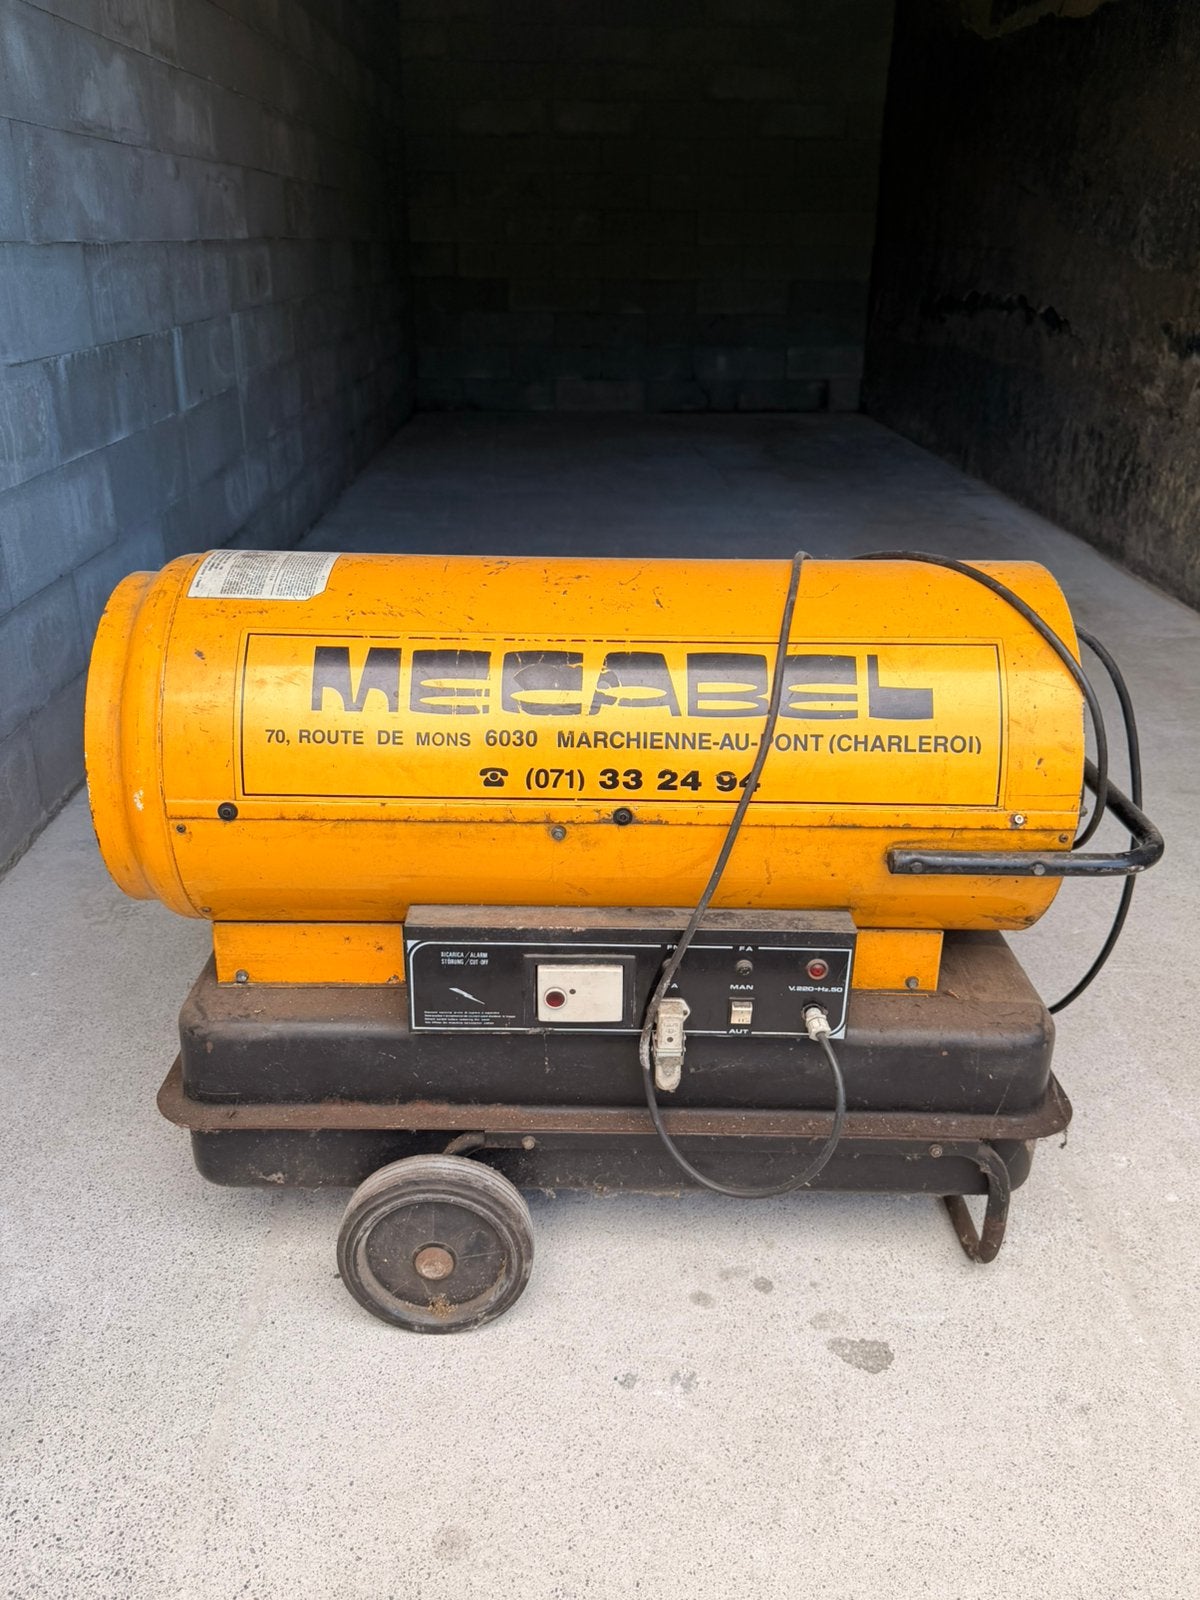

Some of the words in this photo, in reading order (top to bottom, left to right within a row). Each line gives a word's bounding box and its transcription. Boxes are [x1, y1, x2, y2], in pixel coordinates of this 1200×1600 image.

[311, 646, 934, 720] MECABEL
[265, 729, 291, 746] 70,
[299, 729, 364, 745] ROUTE
[377, 730, 403, 746] DE
[416, 732, 471, 747] MONS
[485, 730, 538, 747] 6030
[829, 734, 982, 754] (CHARLEROI)
[525, 768, 585, 791] (071)
[599, 768, 643, 790] 33
[657, 769, 702, 791] 24
[716, 771, 761, 792] 94
